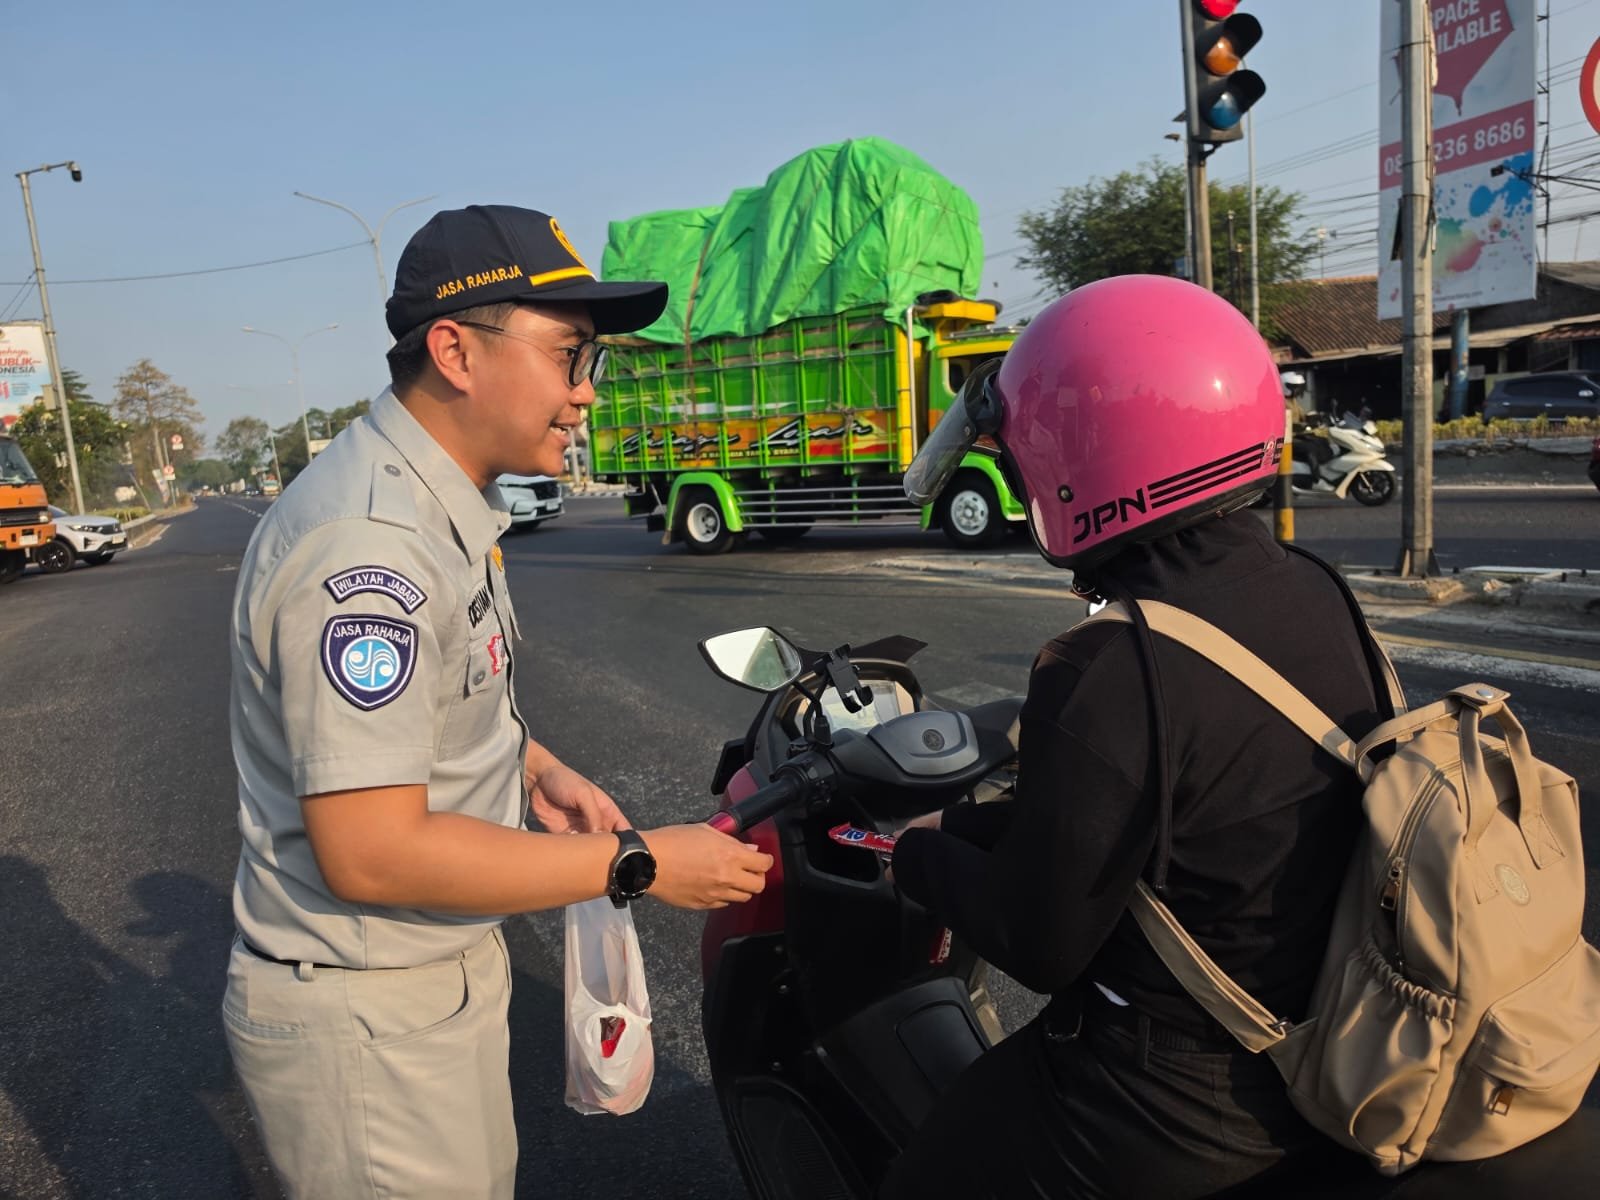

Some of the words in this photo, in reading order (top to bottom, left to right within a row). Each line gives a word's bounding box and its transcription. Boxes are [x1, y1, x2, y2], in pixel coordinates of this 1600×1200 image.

[1431, 0, 1480, 30] PACE
[1473, 118, 1526, 151] 8686
[436, 279, 465, 299] JASA
[466, 265, 523, 289] RAHARJA
[1073, 488, 1147, 544] JPN
[336, 574, 384, 592] WILAYAH
[387, 579, 417, 604] JABAR
[334, 624, 362, 638] JASA
[365, 624, 410, 646] RAHARJA
